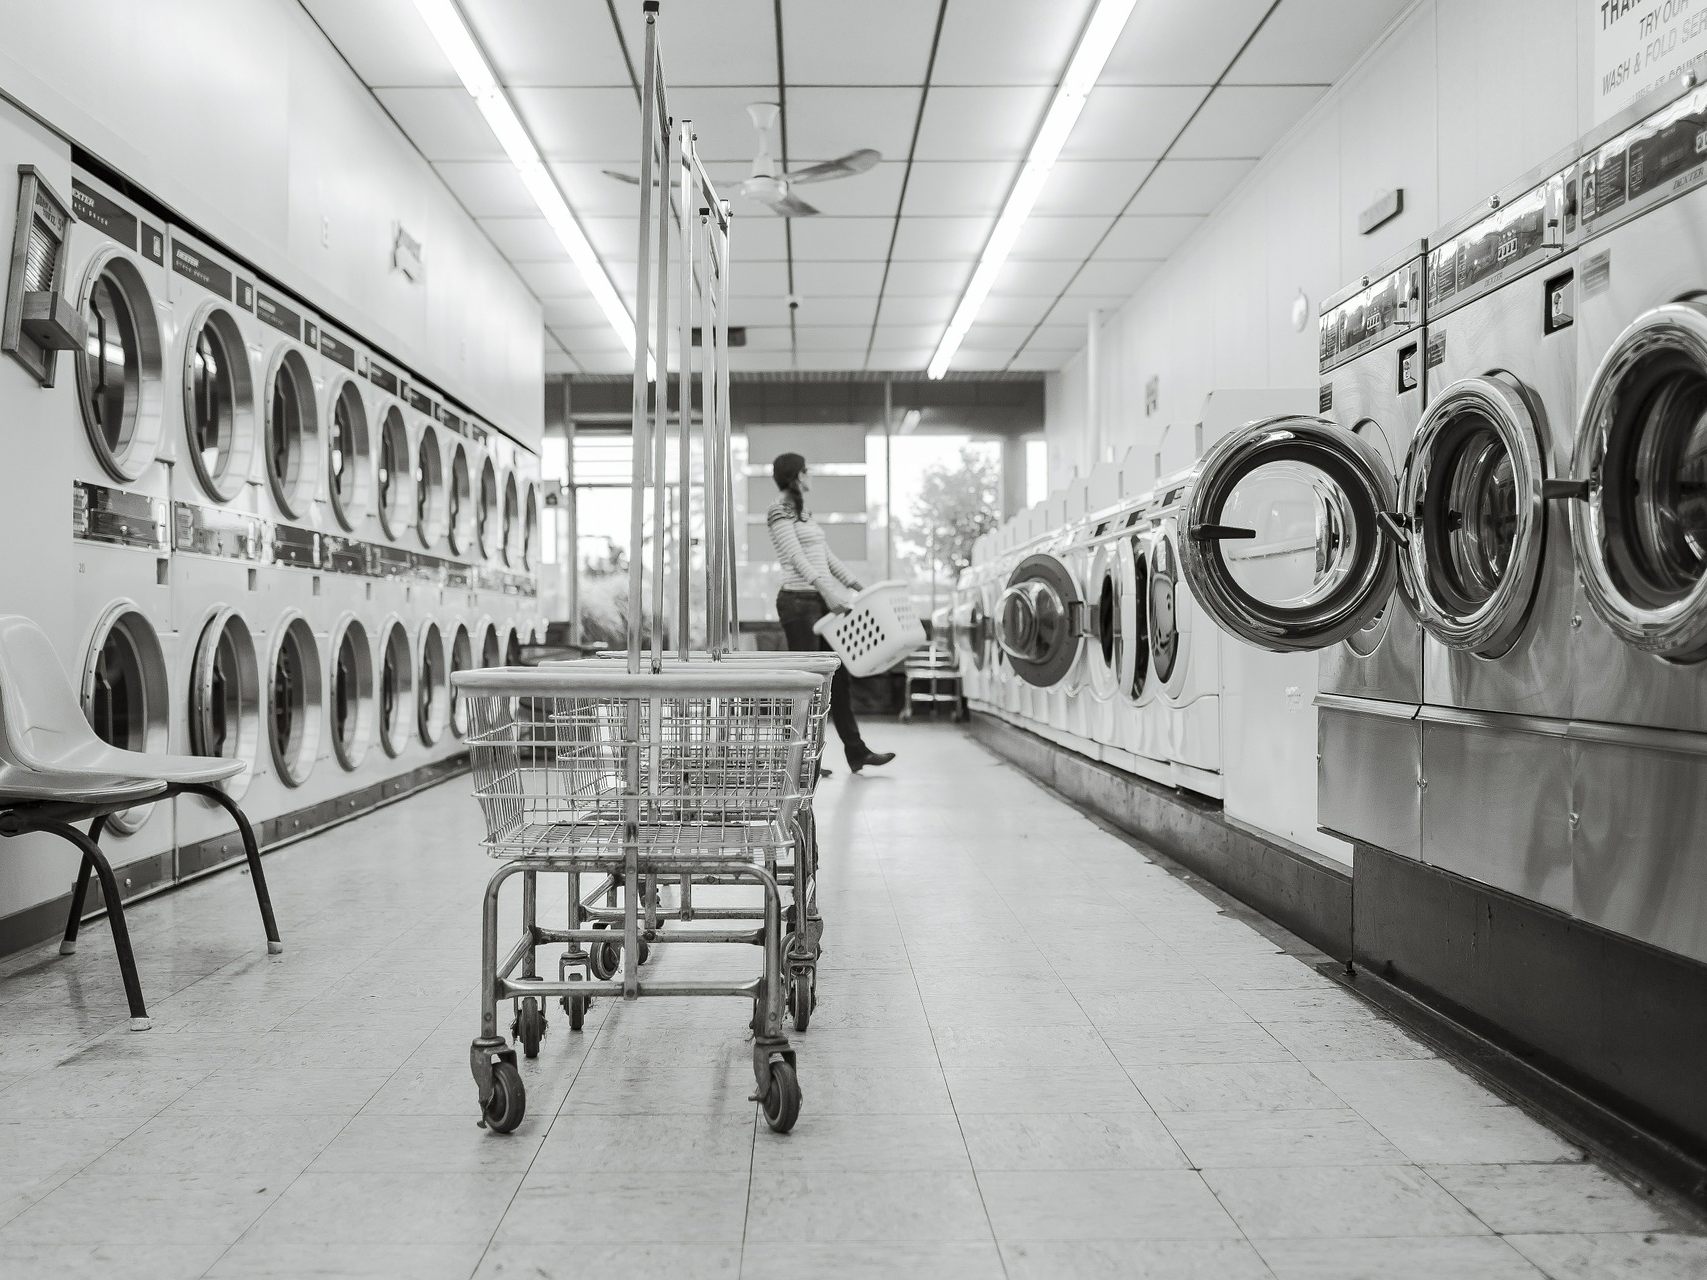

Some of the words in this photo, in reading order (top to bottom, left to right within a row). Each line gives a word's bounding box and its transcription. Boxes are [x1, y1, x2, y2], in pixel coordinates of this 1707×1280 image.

[1639, 5, 1661, 40] TRY
[1602, 57, 1631, 96] WASH
[1633, 52, 1641, 75] &
[1645, 27, 1677, 68] FOLD
